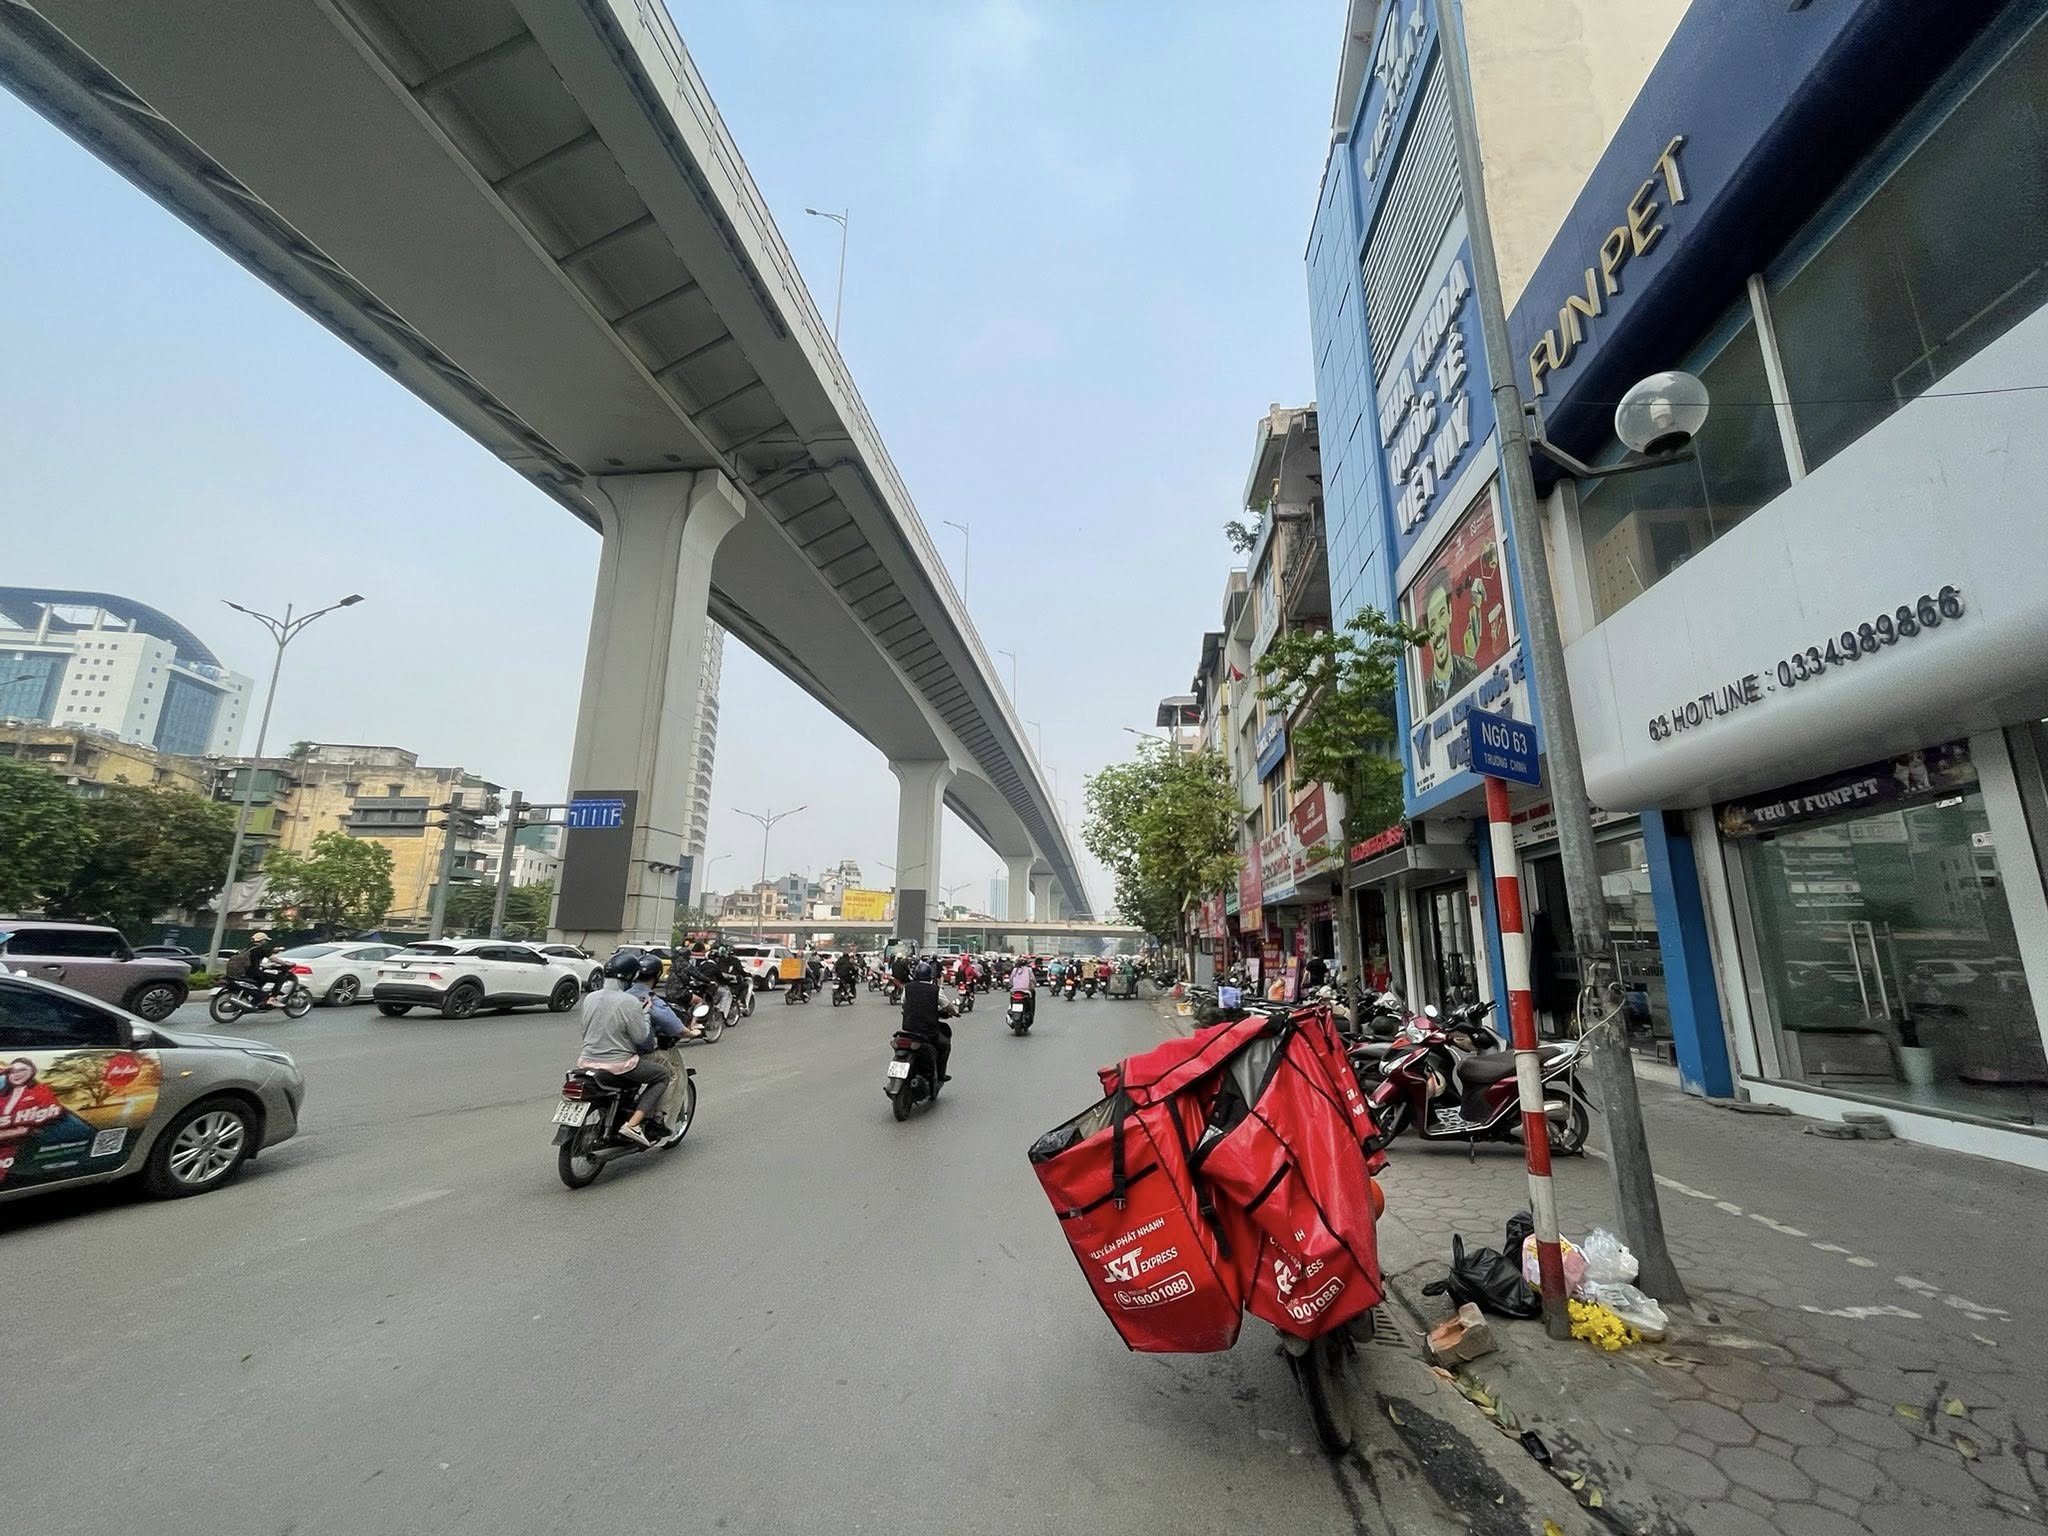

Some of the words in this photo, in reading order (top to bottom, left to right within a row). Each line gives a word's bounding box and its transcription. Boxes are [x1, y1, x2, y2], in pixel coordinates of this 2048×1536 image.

[1530, 135, 1684, 397] FUNPET
[1379, 368, 1415, 448] NHA
[1412, 259, 1471, 383] KHOA
[1390, 390, 1436, 486] QUỐC
[1435, 321, 1467, 402] TẾ
[1397, 455, 1435, 535] VIỆT
[1434, 388, 1470, 480] MỸ
[1649, 714, 1672, 742] 63
[1777, 584, 1965, 688] 0334989866
[1482, 721, 1510, 750] NGÕ
[1513, 731, 1527, 755] 63
[1754, 800, 1785, 822] THÚ
[1790, 800, 1801, 815] Y
[1803, 778, 1880, 813] FUNPET
[14, 1104, 62, 1123] High
[1103, 1247, 1143, 1283] J&T
[1140, 1246, 1178, 1273] EXPRESS
[1115, 1232, 1137, 1248] PHÁT
[1137, 1217, 1165, 1238] NHANH
